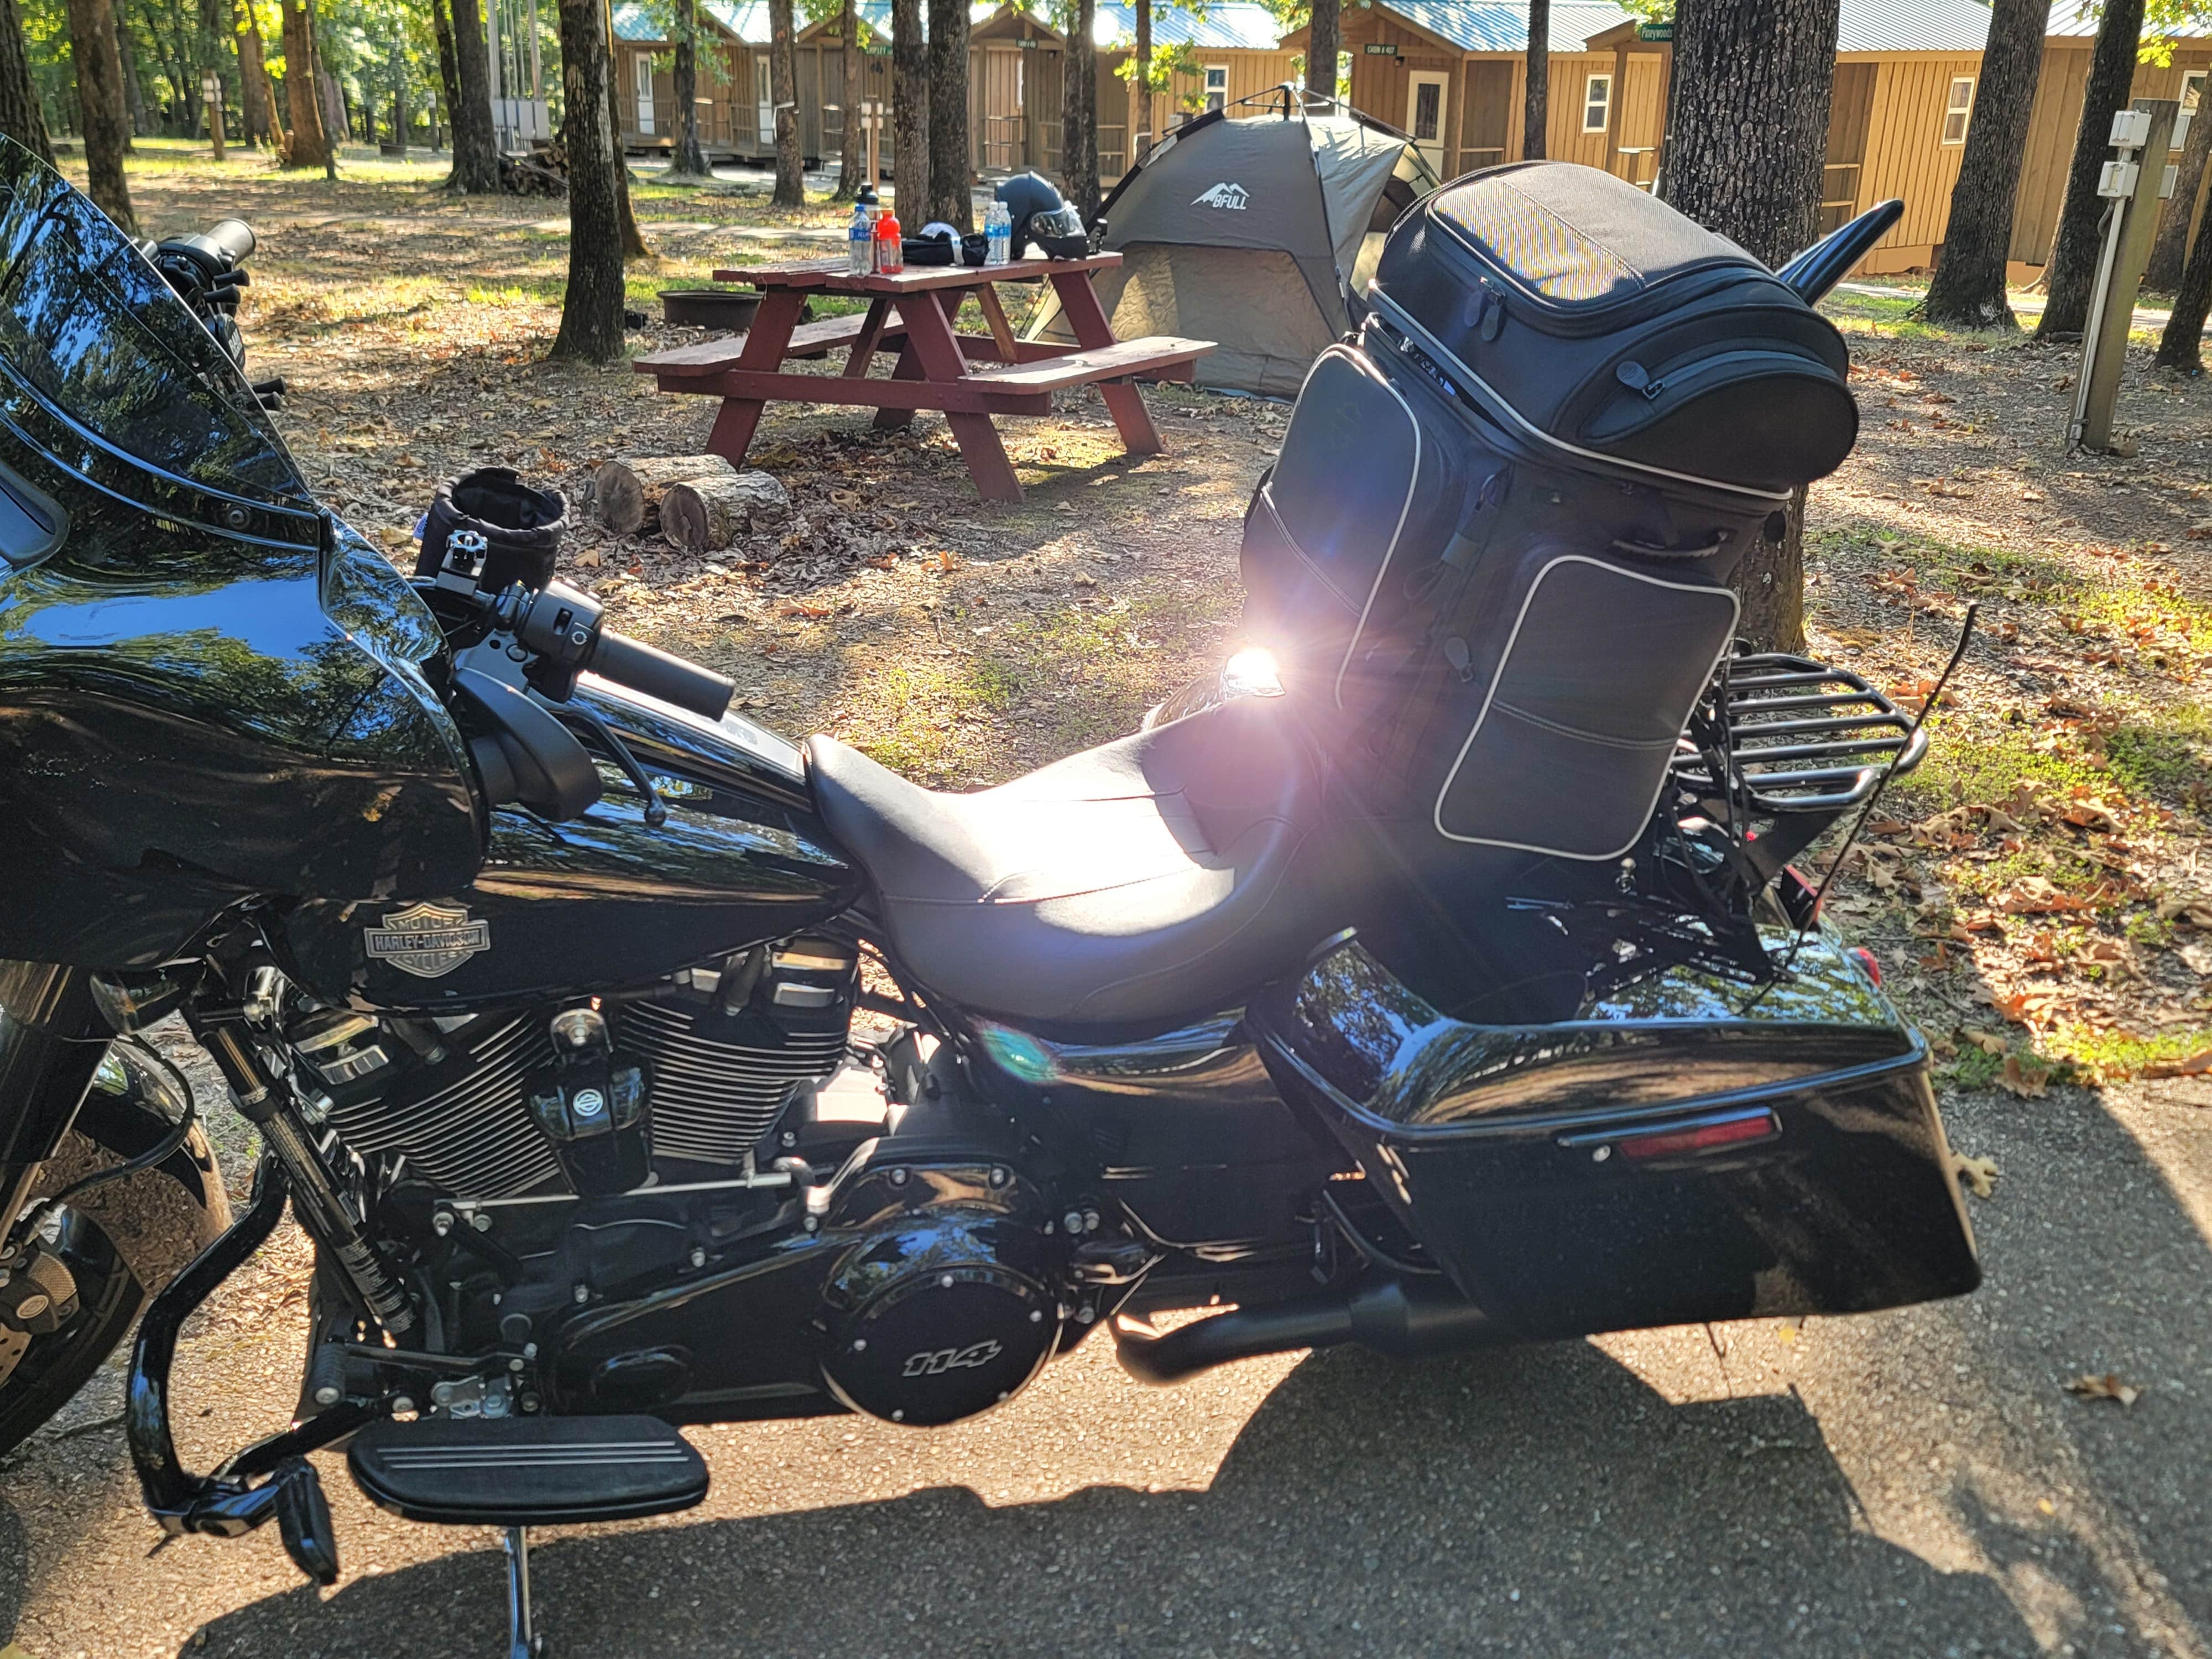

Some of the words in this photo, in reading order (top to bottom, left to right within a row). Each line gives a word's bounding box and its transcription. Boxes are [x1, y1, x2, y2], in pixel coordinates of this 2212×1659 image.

[1641, 27, 1673, 40] Pineywoods
[1212, 194, 1247, 210] BFULL
[398, 914, 455, 930] MOTOR
[374, 929, 480, 951] HARLEY-DAVIDSON
[403, 951, 458, 969] CYCLES
[901, 1339, 1003, 1377] 114
